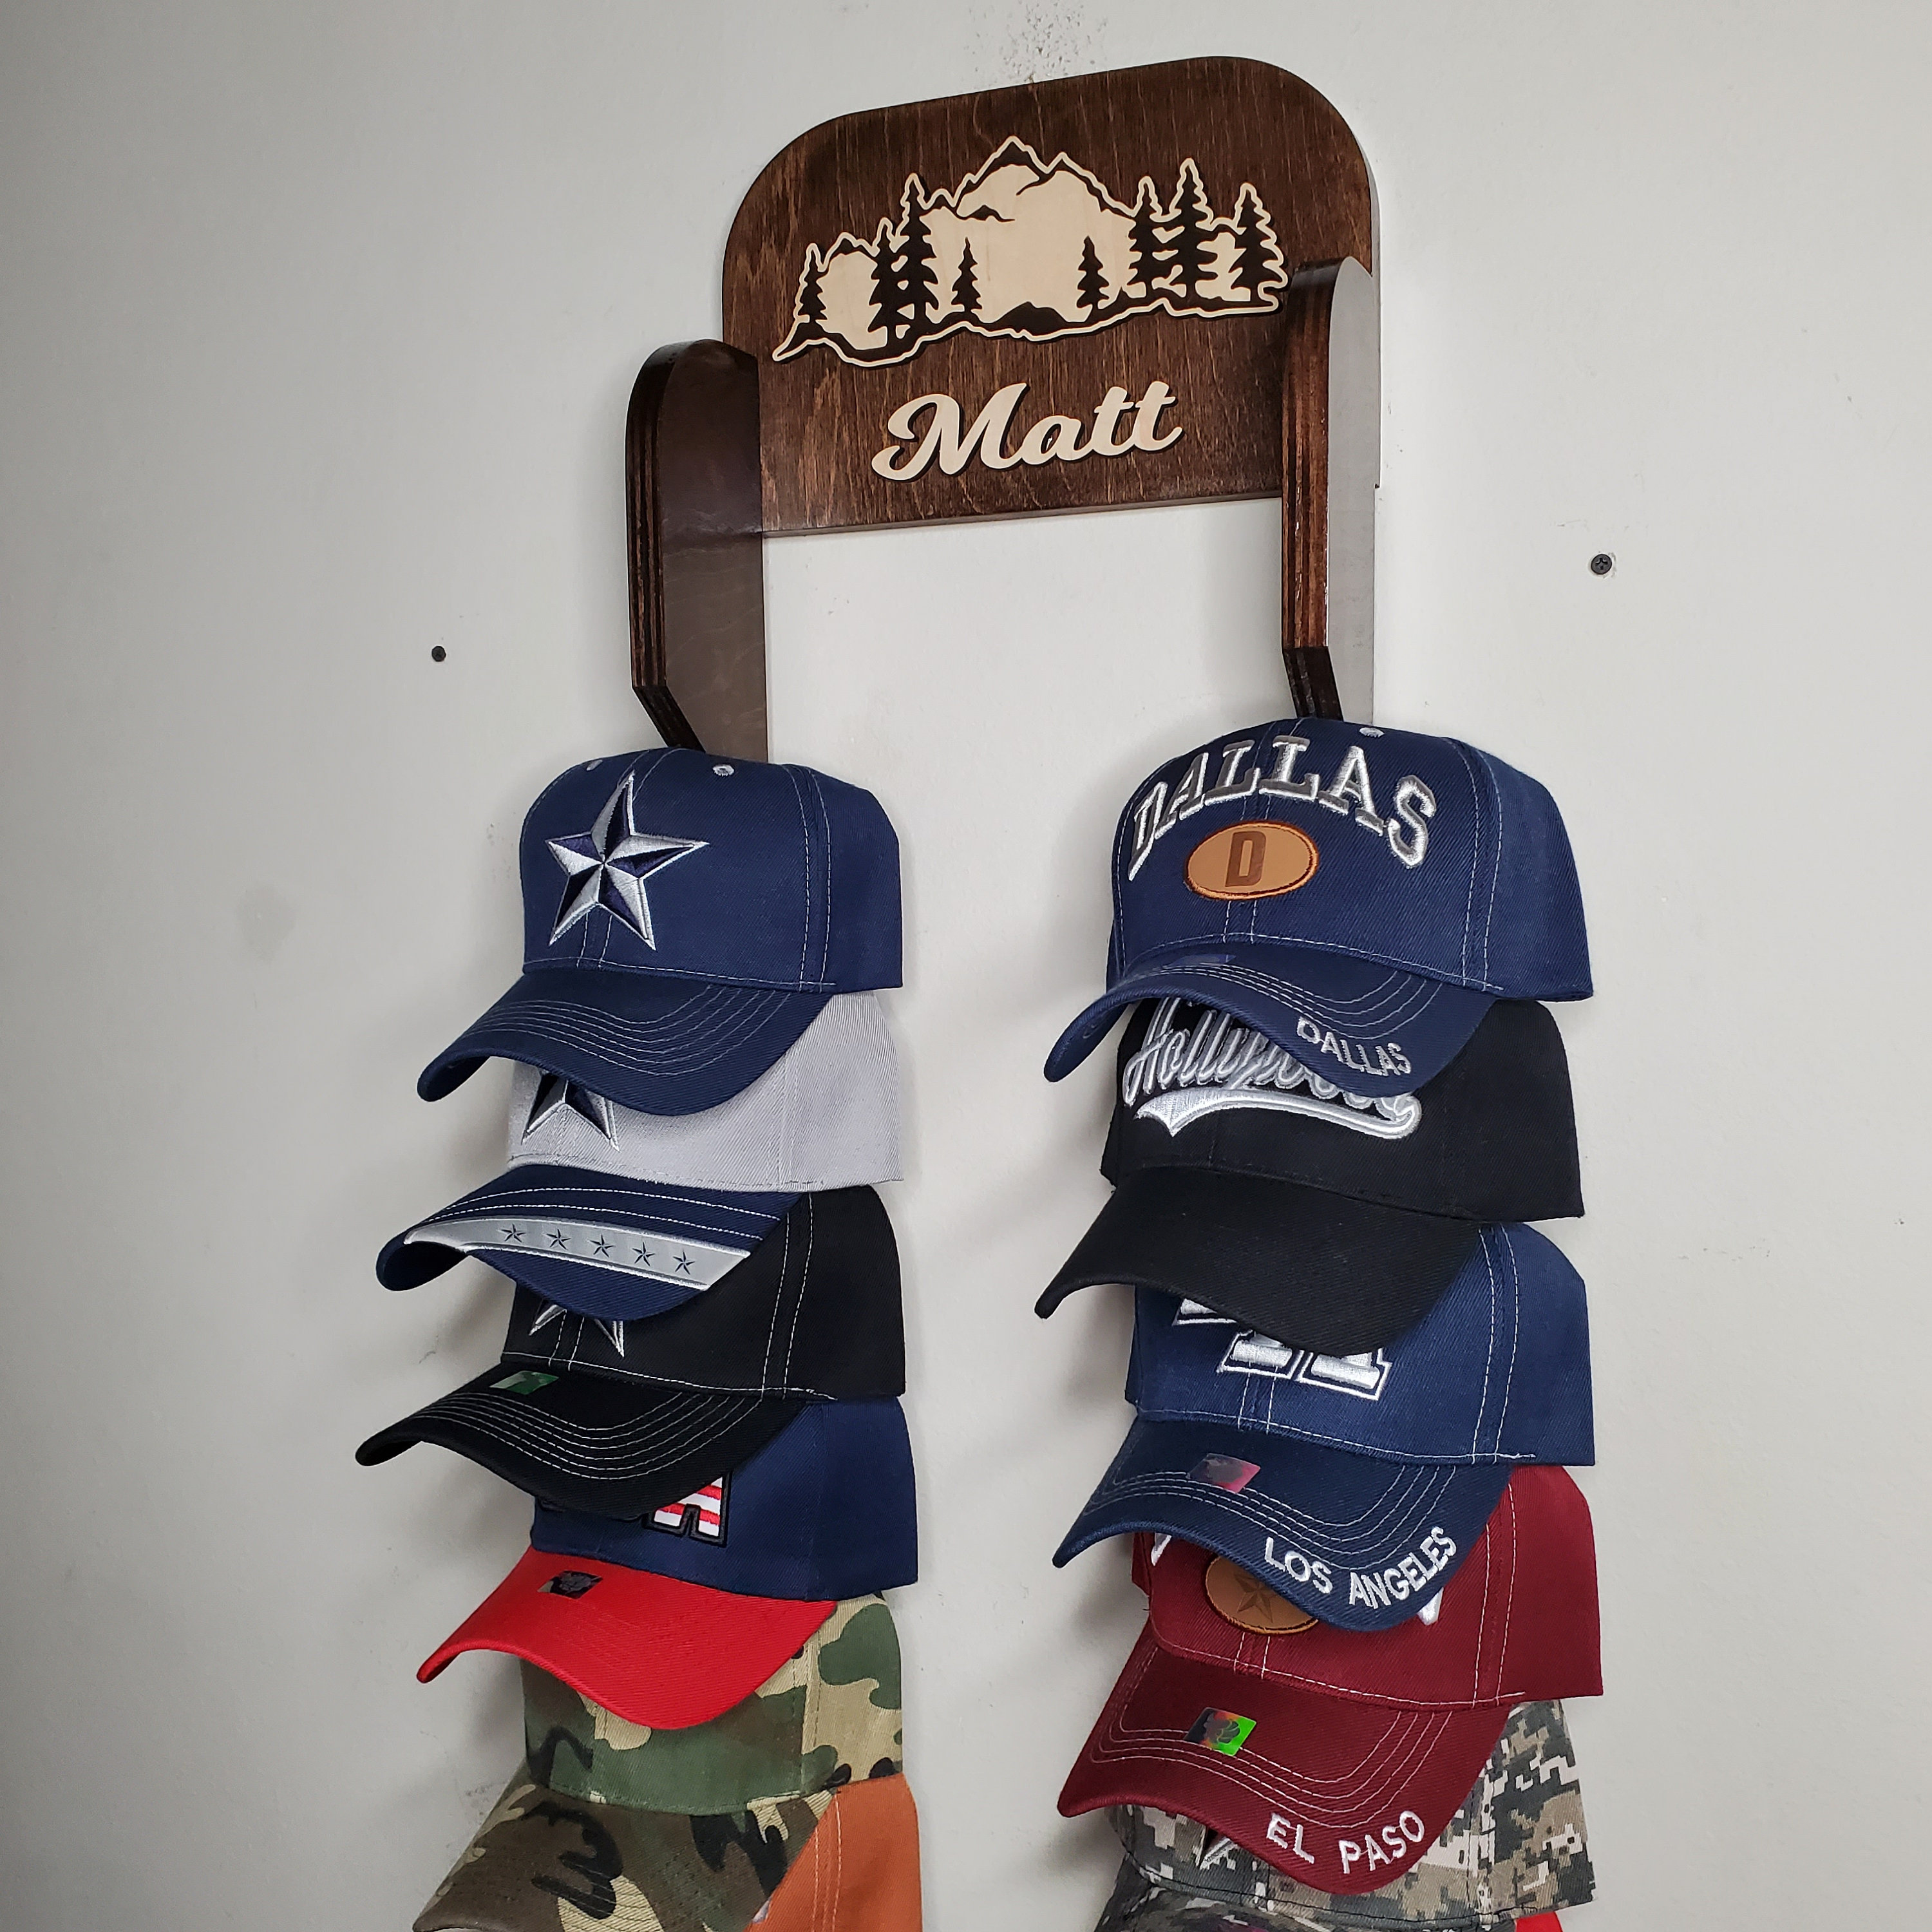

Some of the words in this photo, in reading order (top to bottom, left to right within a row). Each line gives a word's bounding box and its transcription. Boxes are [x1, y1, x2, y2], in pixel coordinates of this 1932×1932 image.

[871, 381, 1183, 480] Matt
[1128, 735, 1437, 882] DALLAS
[1225, 830, 1266, 887] D
[1297, 1016, 1412, 1077] DALLAS
[1265, 1537, 1333, 1594] LOS
[1349, 1526, 1457, 1609] ANGELES
[1266, 1812, 1315, 1864] EL
[1338, 1810, 1425, 1874] PASO
